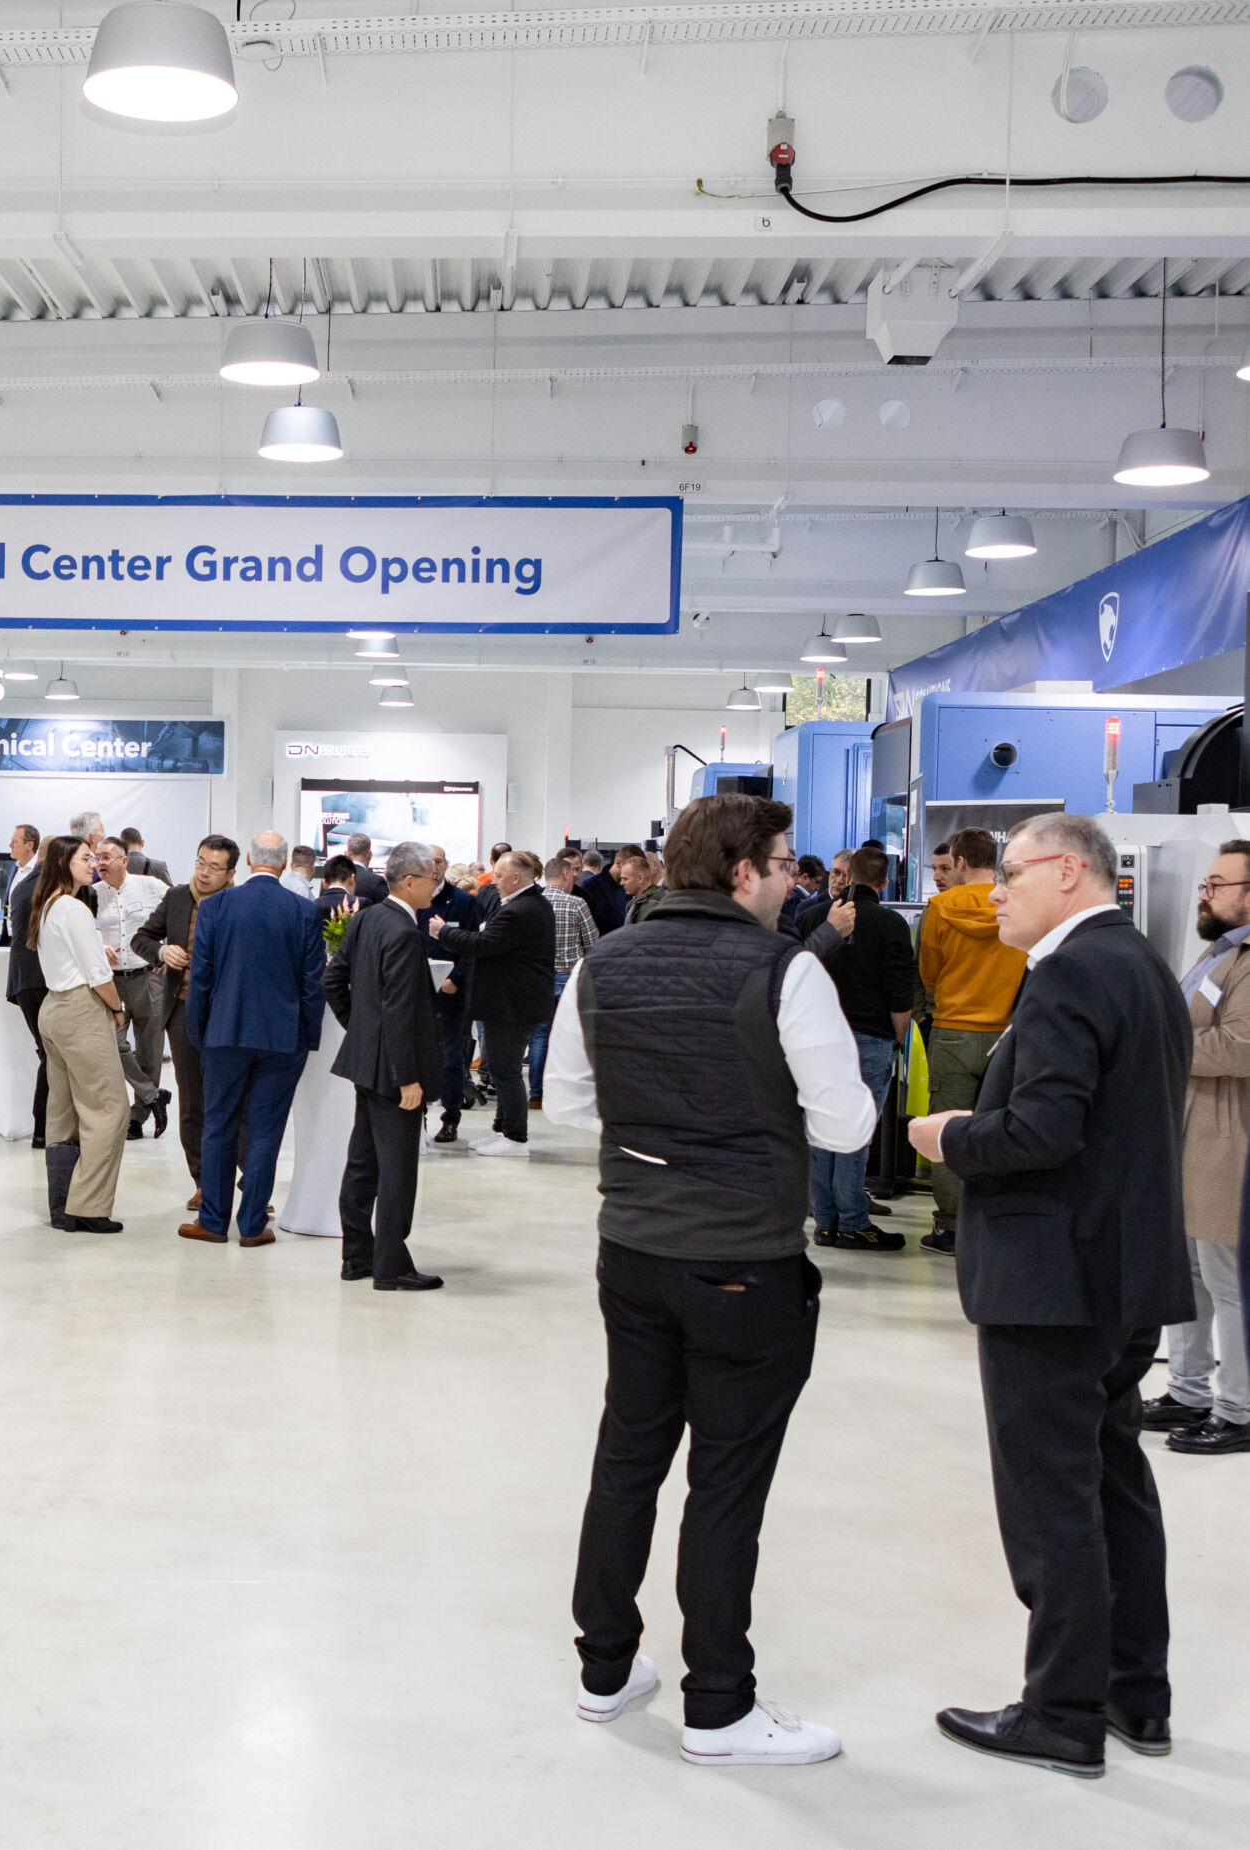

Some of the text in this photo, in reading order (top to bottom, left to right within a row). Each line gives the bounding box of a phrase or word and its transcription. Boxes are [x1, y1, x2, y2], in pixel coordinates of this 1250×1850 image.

[679, 482, 701, 491] 6F19
[21, 543, 173, 582] Center
[185, 544, 324, 583] Grand
[339, 546, 543, 596] Opening
[62, 734, 152, 758] Center
[287, 744, 319, 756] DN
